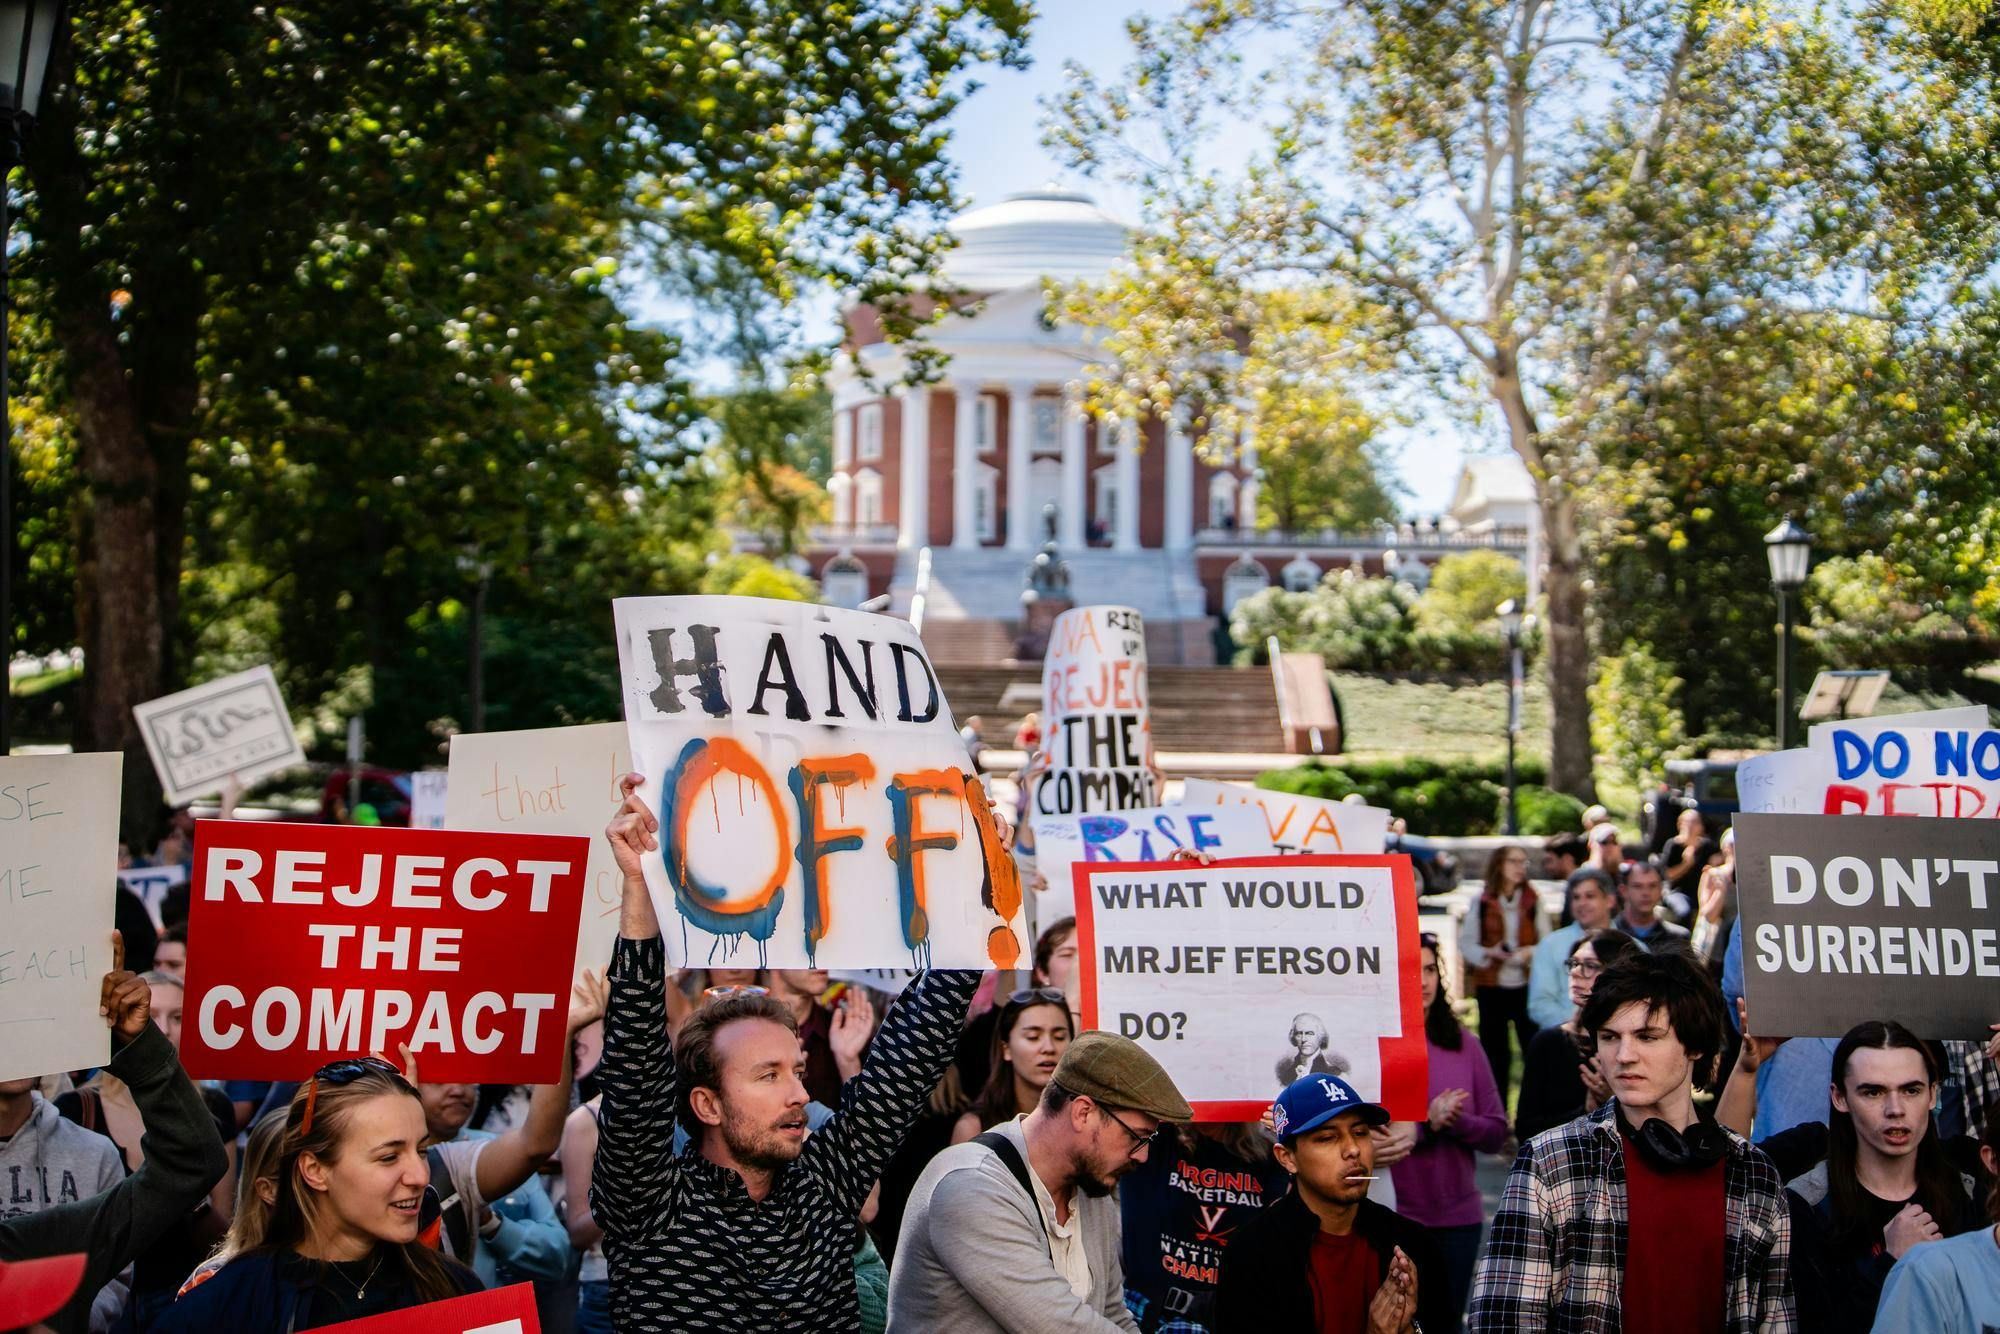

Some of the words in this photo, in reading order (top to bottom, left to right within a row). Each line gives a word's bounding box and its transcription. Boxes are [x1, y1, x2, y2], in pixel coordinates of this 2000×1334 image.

[1063, 715, 1140, 768] THE
[1833, 729, 1910, 780] DO
[1935, 730, 2000, 781] NO
[481, 761, 567, 821] that
[660, 737, 1022, 969] OFF!
[204, 848, 571, 913] REJECT
[1097, 882, 1207, 909] WHAT
[1223, 881, 1364, 908] WOULD
[1770, 855, 1998, 909] DON'T
[308, 924, 463, 972] THE
[1755, 923, 2000, 977] SURRENDE
[198, 985, 556, 1055] COMPACT
[1119, 1012, 1187, 1040] DO?
[1317, 1079, 1349, 1102] LA
[1168, 1172, 1263, 1208] BASKETBALL
[1176, 1159, 1263, 1194] VIRGINIA
